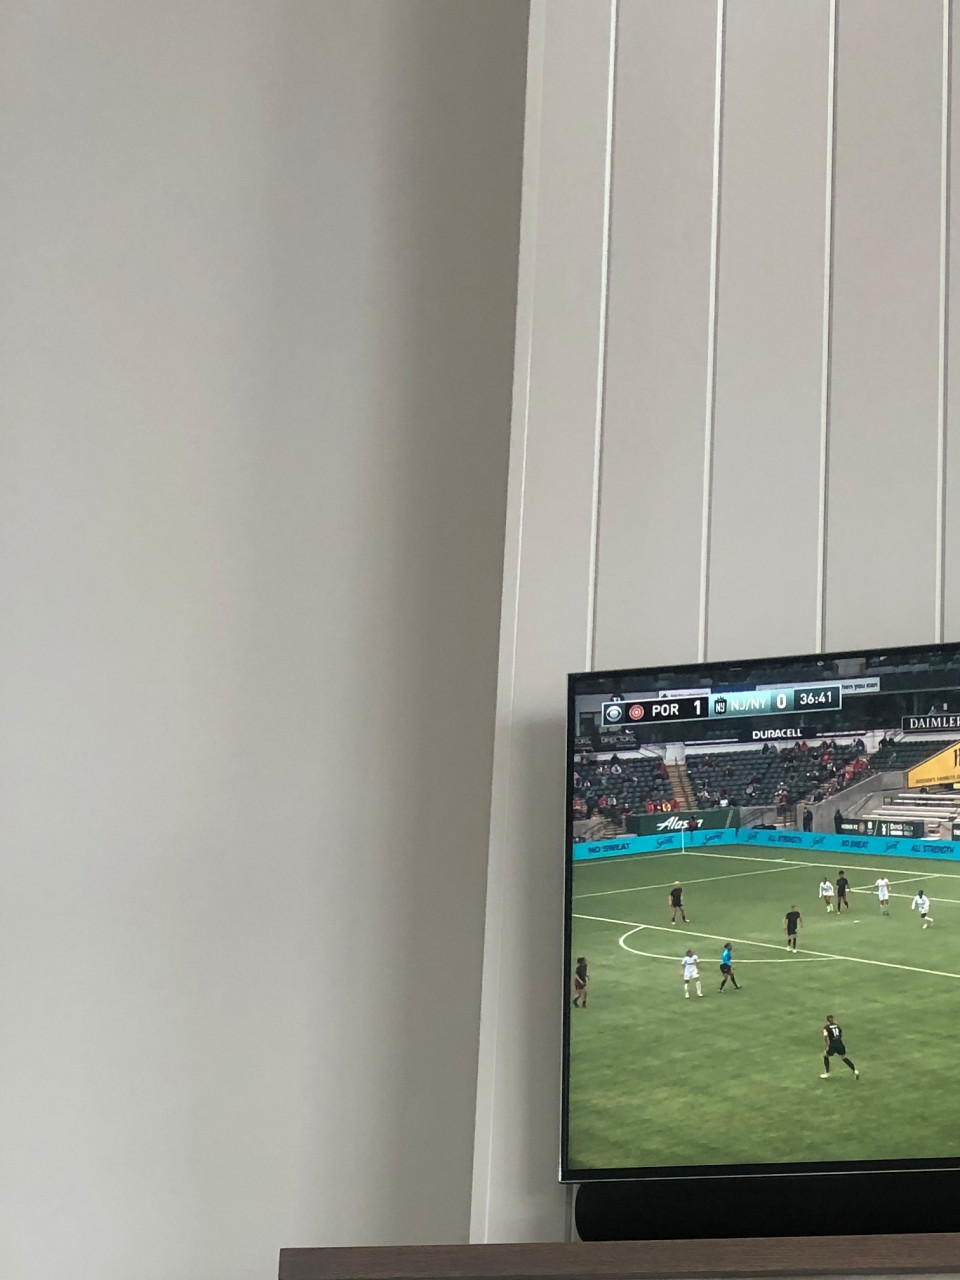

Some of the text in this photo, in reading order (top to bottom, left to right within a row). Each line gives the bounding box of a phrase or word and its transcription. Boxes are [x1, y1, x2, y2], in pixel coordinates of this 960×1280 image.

[731, 693, 787, 711] NJ/NY 0
[800, 691, 832, 705] 36:41
[652, 700, 701, 717] POR 1
[752, 728, 803, 739] DURACELL
[602, 843, 631, 852] SWEAT
[923, 845, 955, 854] STRENGTH
